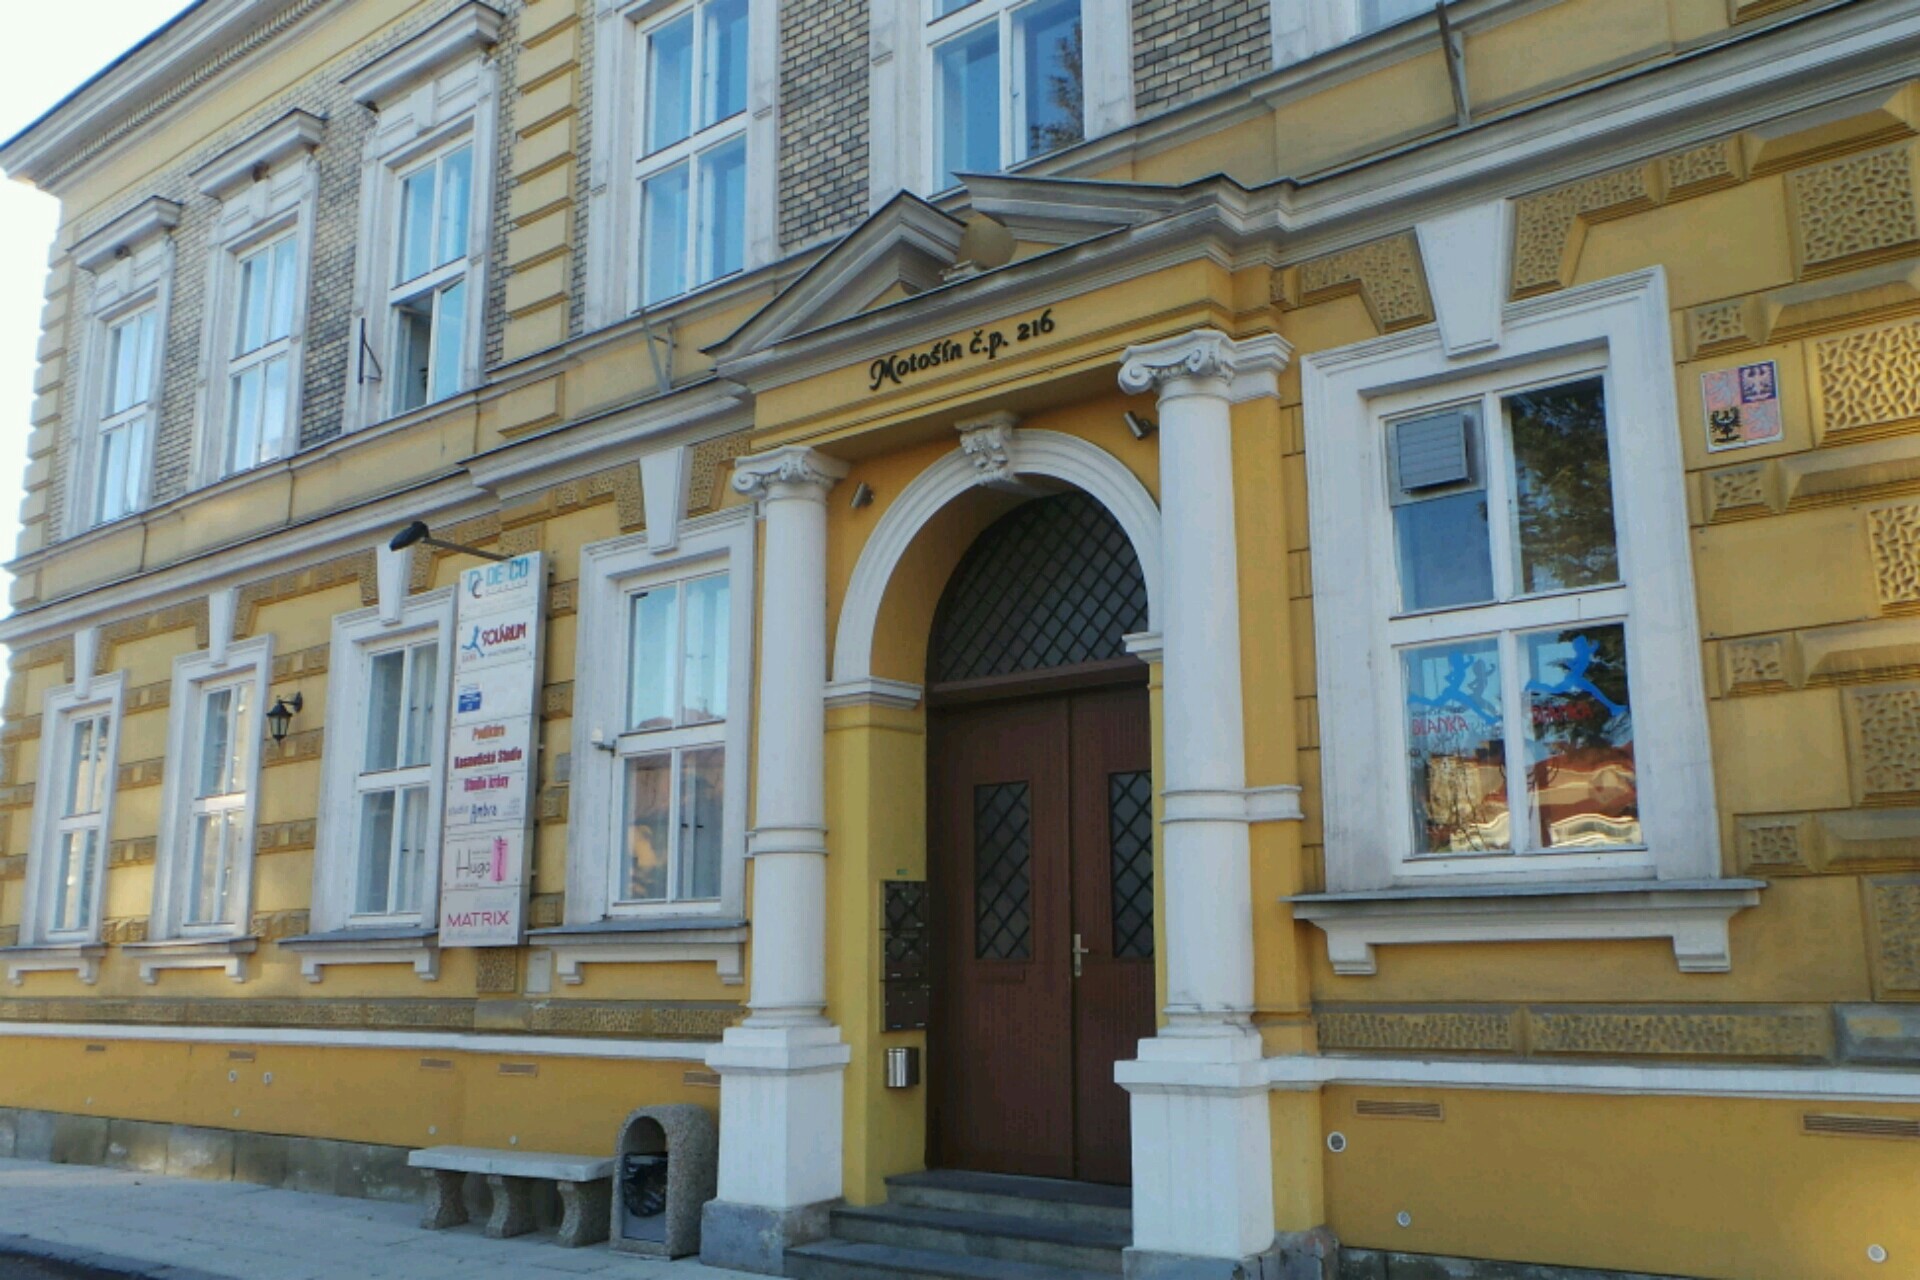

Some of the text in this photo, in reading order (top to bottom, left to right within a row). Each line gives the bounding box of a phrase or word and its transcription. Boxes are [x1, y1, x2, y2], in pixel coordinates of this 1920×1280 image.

[1017, 307, 1056, 341] 216
[456, 847, 491, 880] Hugo
[446, 909, 511, 928] MATRIX
